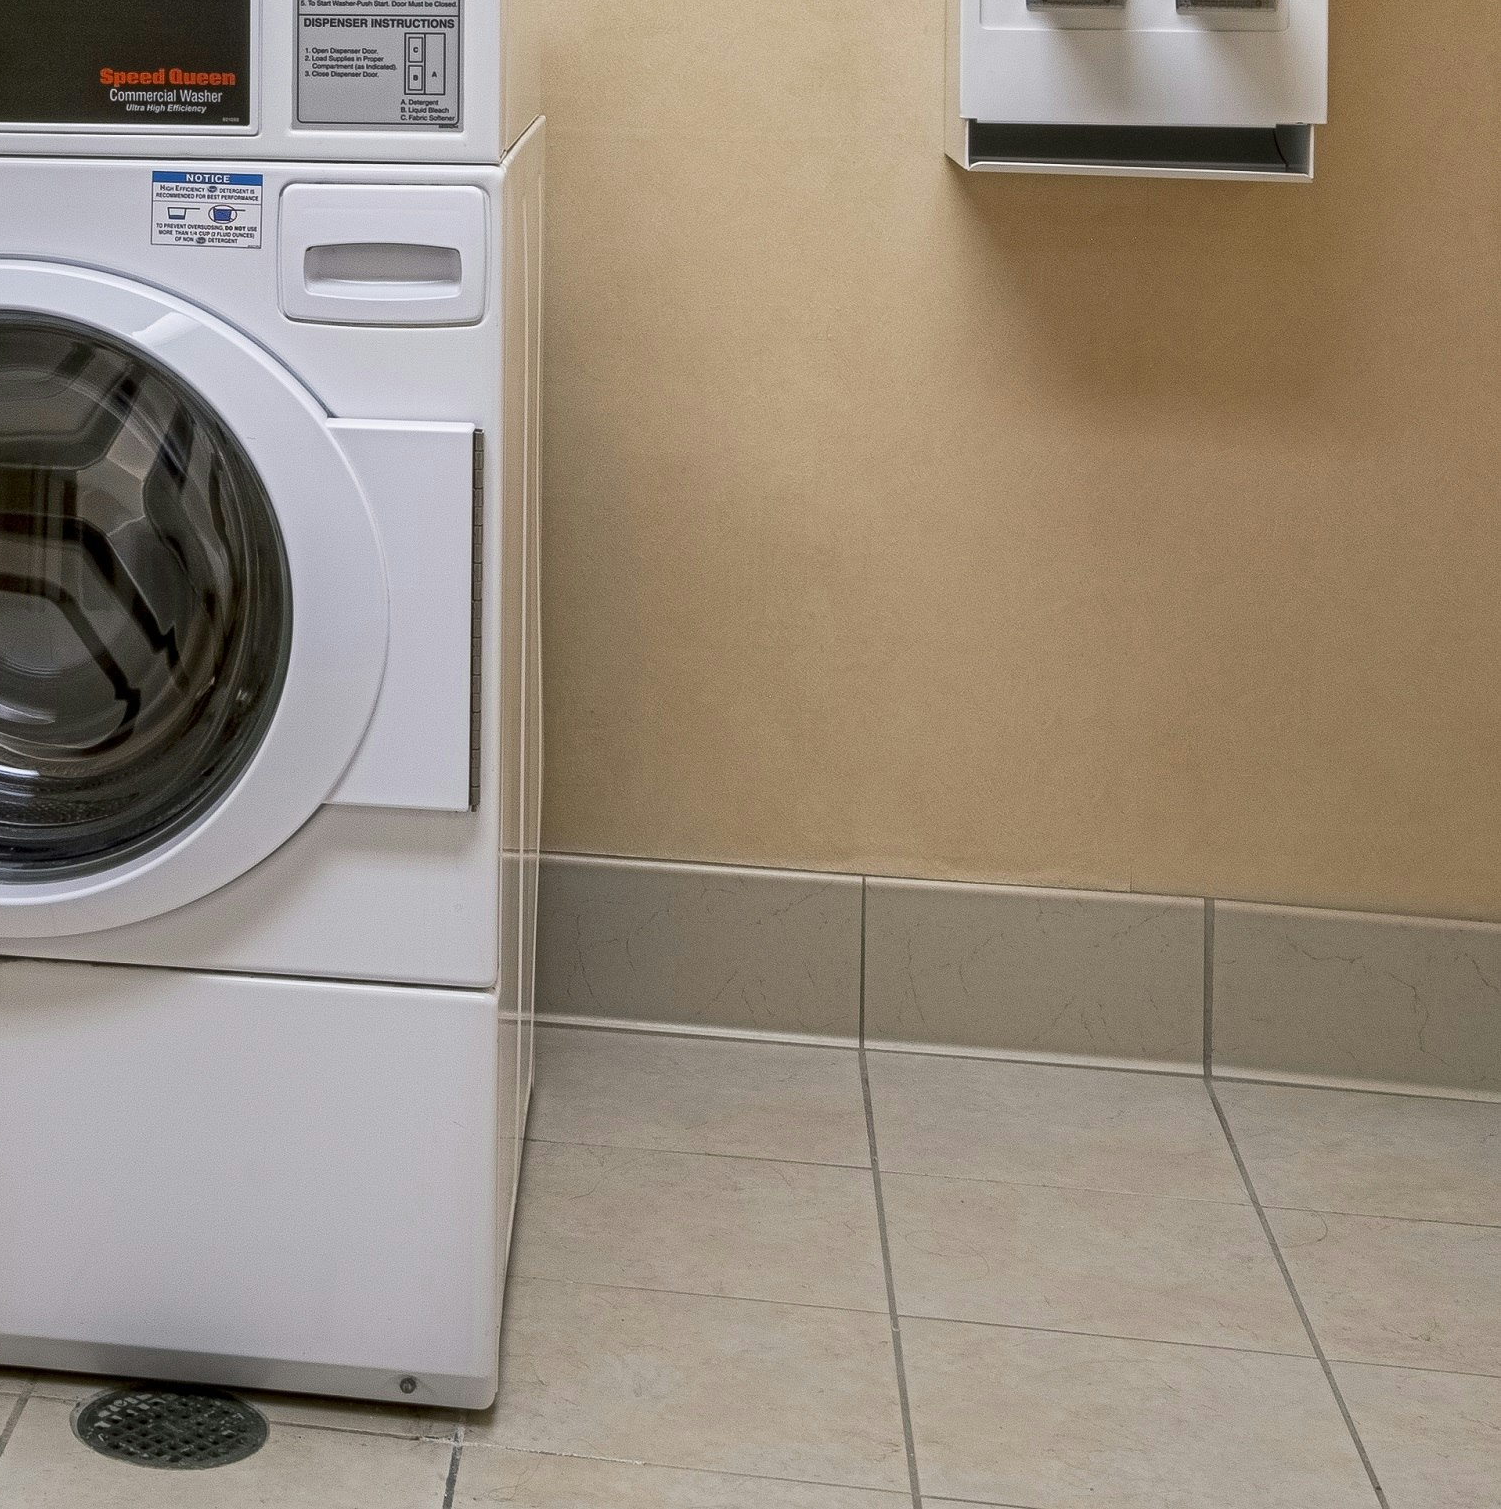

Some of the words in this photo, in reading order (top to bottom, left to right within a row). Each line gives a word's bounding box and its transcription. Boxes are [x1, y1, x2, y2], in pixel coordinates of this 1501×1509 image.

[303, 18, 368, 28] DISPENSER
[371, 18, 455, 29] INSTRUCTIONS
[363, 56, 384, 64] Proper
[312, 63, 354, 71] Compartment
[100, 67, 165, 87] Speed
[169, 68, 236, 86] Queen
[330, 71, 361, 79] Dispenser
[109, 88, 176, 102] Commercial
[180, 89, 223, 103] Washer
[408, 99, 439, 107] Detergent
[146, 104, 166, 113] High
[167, 104, 207, 114] Efficiency
[408, 107, 427, 115] Liquid
[186, 174, 230, 183] NOTICE
